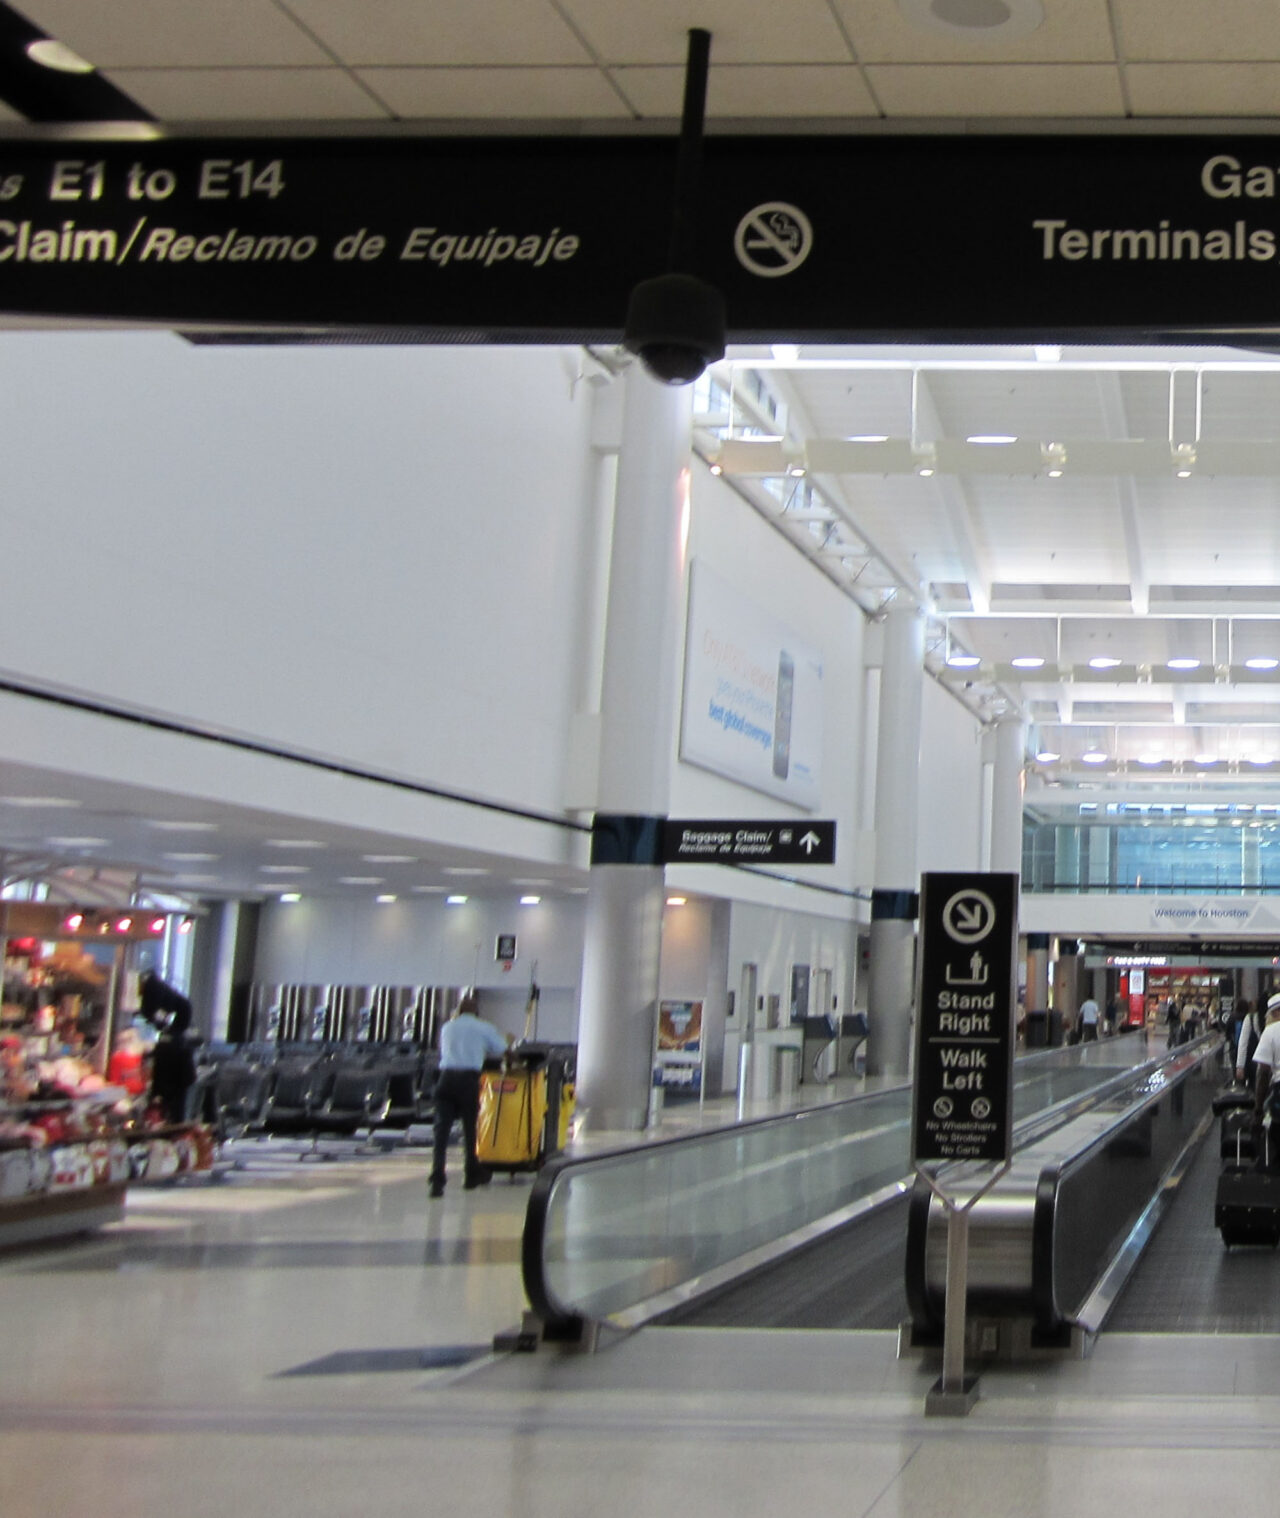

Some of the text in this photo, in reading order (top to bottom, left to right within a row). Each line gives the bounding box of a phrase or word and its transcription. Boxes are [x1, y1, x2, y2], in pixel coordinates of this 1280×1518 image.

[49, 161, 105, 201] E1
[127, 163, 176, 201] to
[199, 160, 284, 199] E14
[333, 228, 386, 260] de
[400, 227, 579, 267] Equipaje
[682, 829, 732, 844] Baggage
[1154, 908, 1249, 918] Welcome to Houston
[937, 990, 995, 1010] Stand
[939, 1012, 990, 1035] Right
[940, 1048, 987, 1068] Walk
[942, 1071, 983, 1090] Left
[926, 1121, 997, 1131] No Wheelchairs
[935, 1133, 948, 1142] No
[941, 1145, 954, 1154] No
